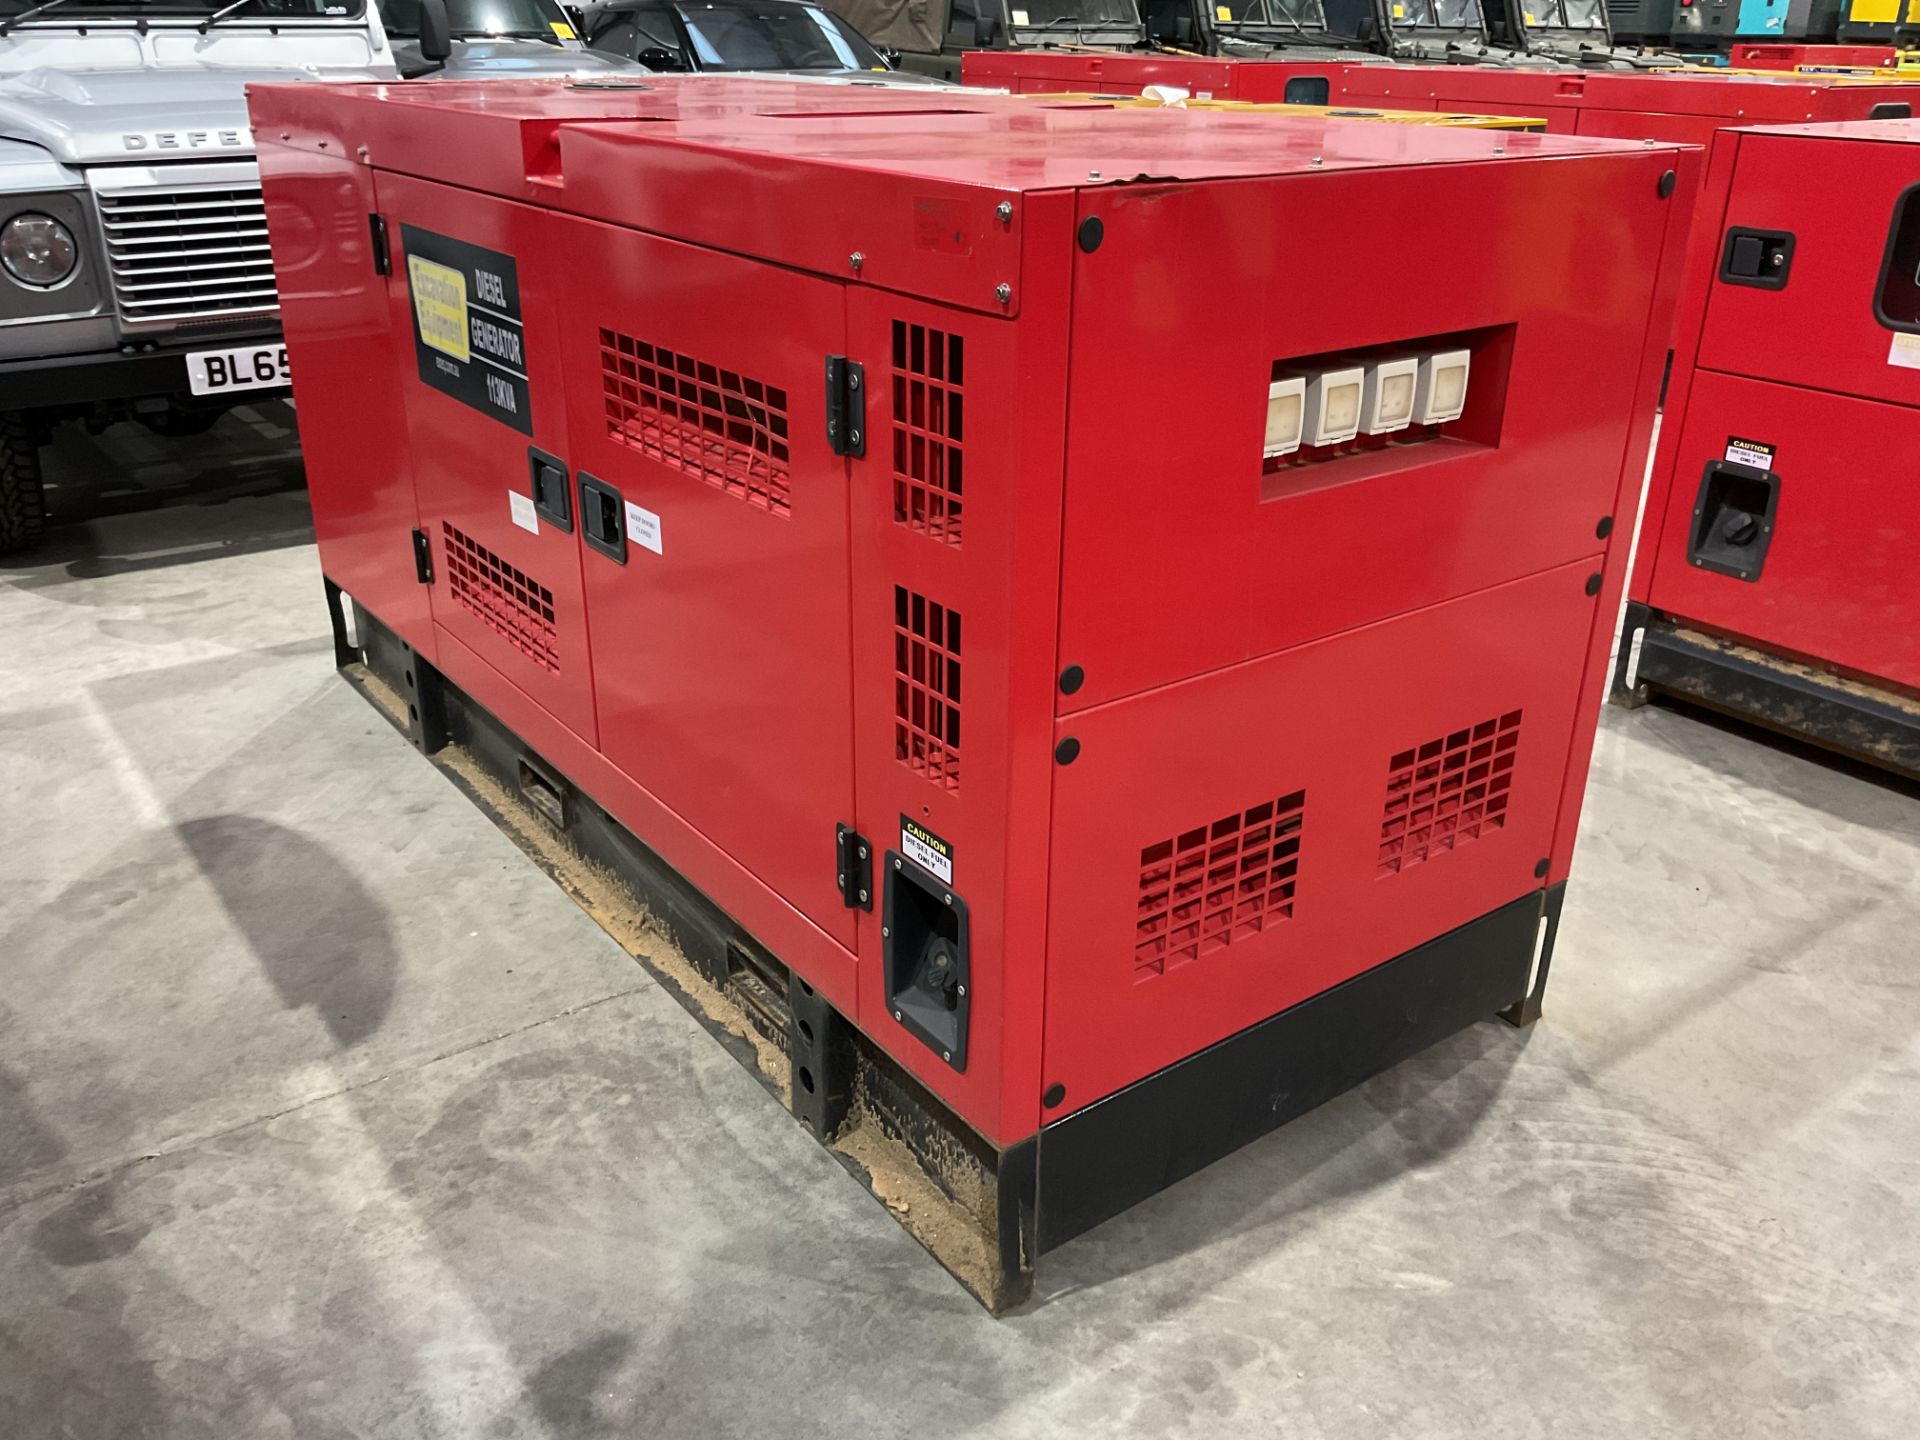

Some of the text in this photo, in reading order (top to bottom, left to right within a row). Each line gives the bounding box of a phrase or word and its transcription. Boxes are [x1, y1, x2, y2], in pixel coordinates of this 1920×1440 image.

[475, 268, 507, 308] DIESEL
[471, 316, 522, 366] GENERATOR
[486, 373, 517, 414] 113KVA
[1730, 449, 1750, 457] DIESEL
[1733, 440, 1769, 453] CAUTION
[905, 835, 947, 868] DIESEL FUEL
[907, 823, 947, 856] CAUTION
[917, 852, 935, 869] ONLY
